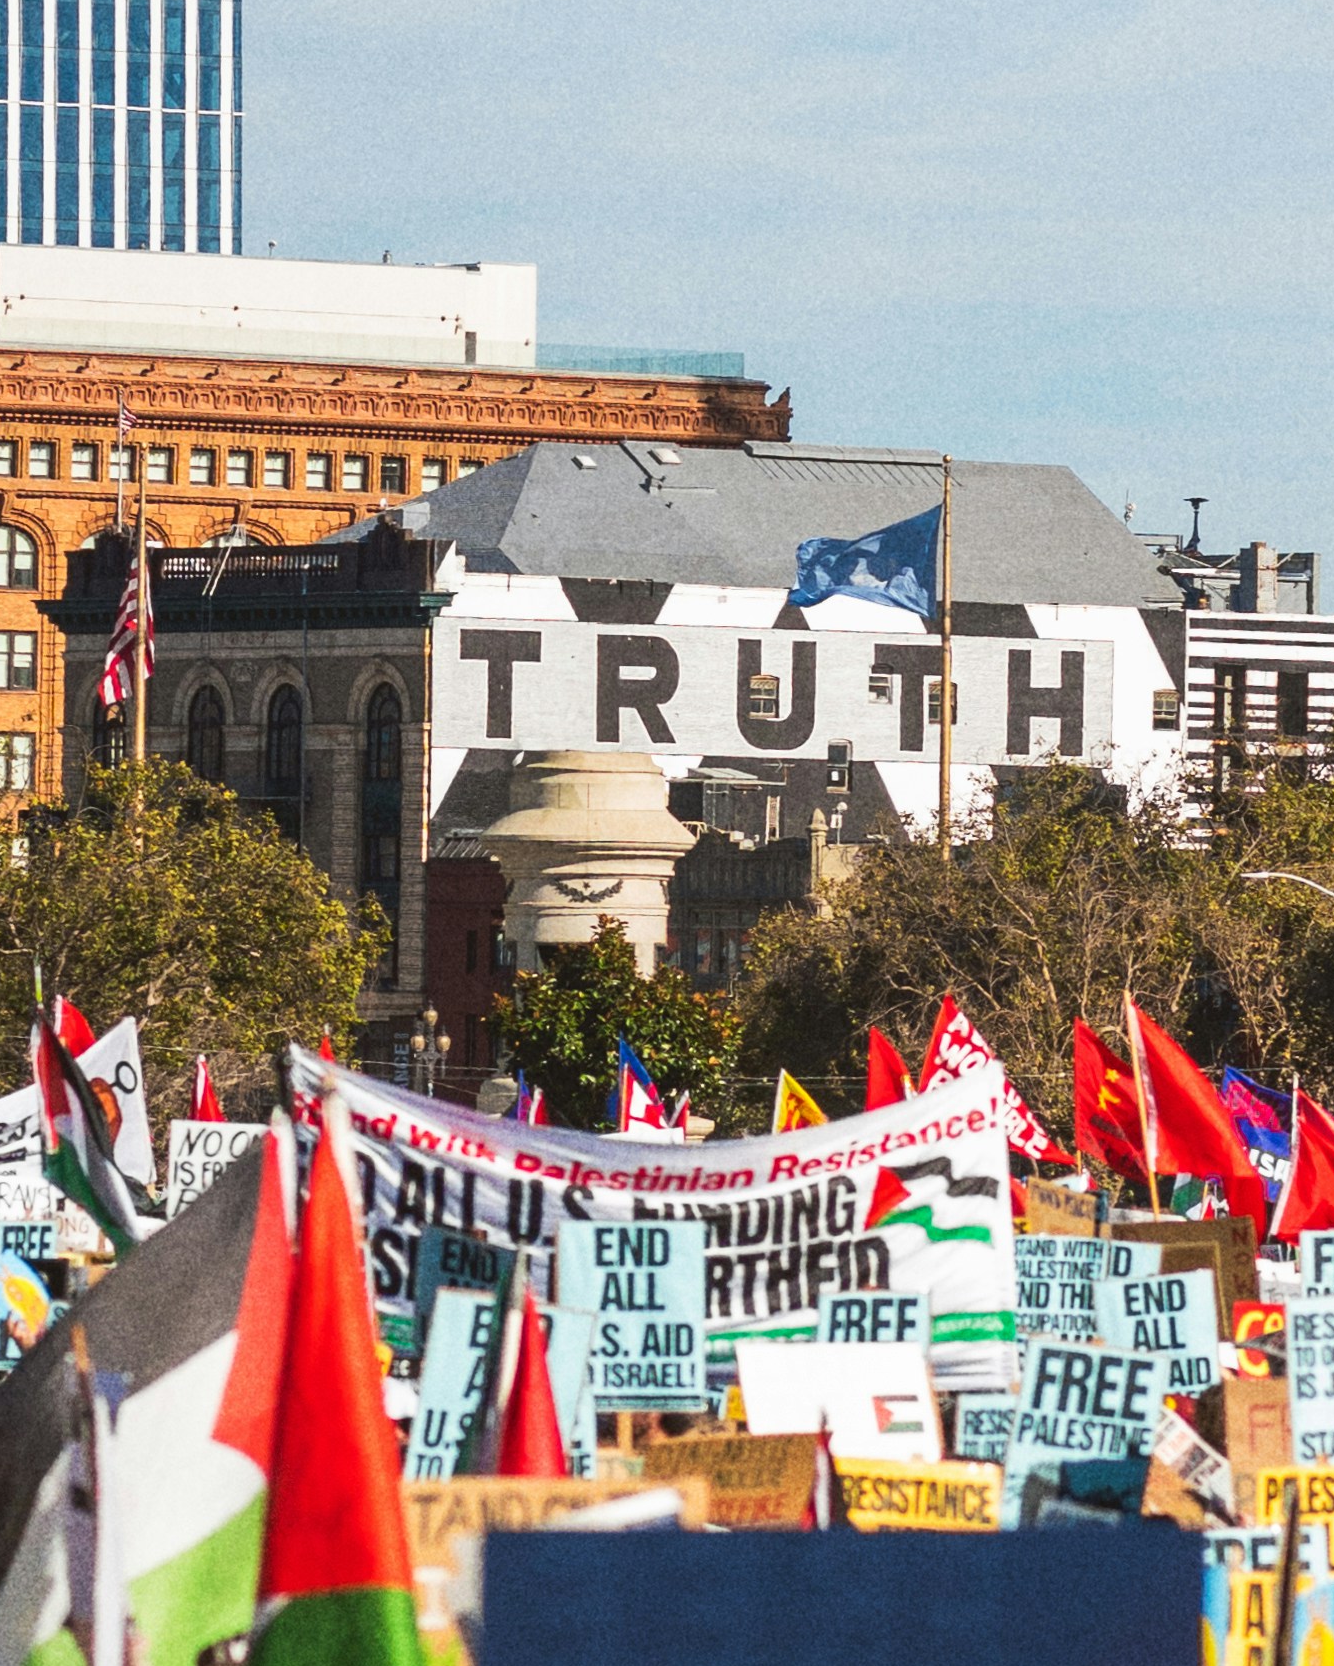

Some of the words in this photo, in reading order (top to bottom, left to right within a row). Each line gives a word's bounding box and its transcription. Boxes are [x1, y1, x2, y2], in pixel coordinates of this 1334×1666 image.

[460, 629, 1086, 755] TRUTH
[179, 1128, 223, 1157] NO
[769, 1097, 998, 1183] Resistance!
[174, 1161, 195, 1186] IS
[394, 1157, 475, 1233] ALL
[3, 1226, 52, 1258] FREE
[441, 1237, 498, 1283] END
[595, 1227, 669, 1267] END
[1063, 1240, 1103, 1258] WITH
[600, 1272, 665, 1311] ALL
[705, 1236, 890, 1319] RTHEID
[1019, 1281, 1050, 1308] ND
[1123, 1279, 1186, 1317] END
[829, 1297, 918, 1342] FREE
[1134, 1317, 1186, 1352] ALL
[591, 1324, 629, 1357] .S.
[642, 1323, 694, 1357] AID
[1296, 1344, 1316, 1367] TO
[604, 1363, 695, 1389] ISRAEL!
[1033, 1348, 1154, 1421] FREE
[1169, 1356, 1211, 1387] AID
[1296, 1373, 1317, 1398] IS
[963, 1410, 1014, 1436] RESIS
[1016, 1413, 1154, 1457] PALESTINE
[842, 1472, 995, 1527] RESISTANCE
